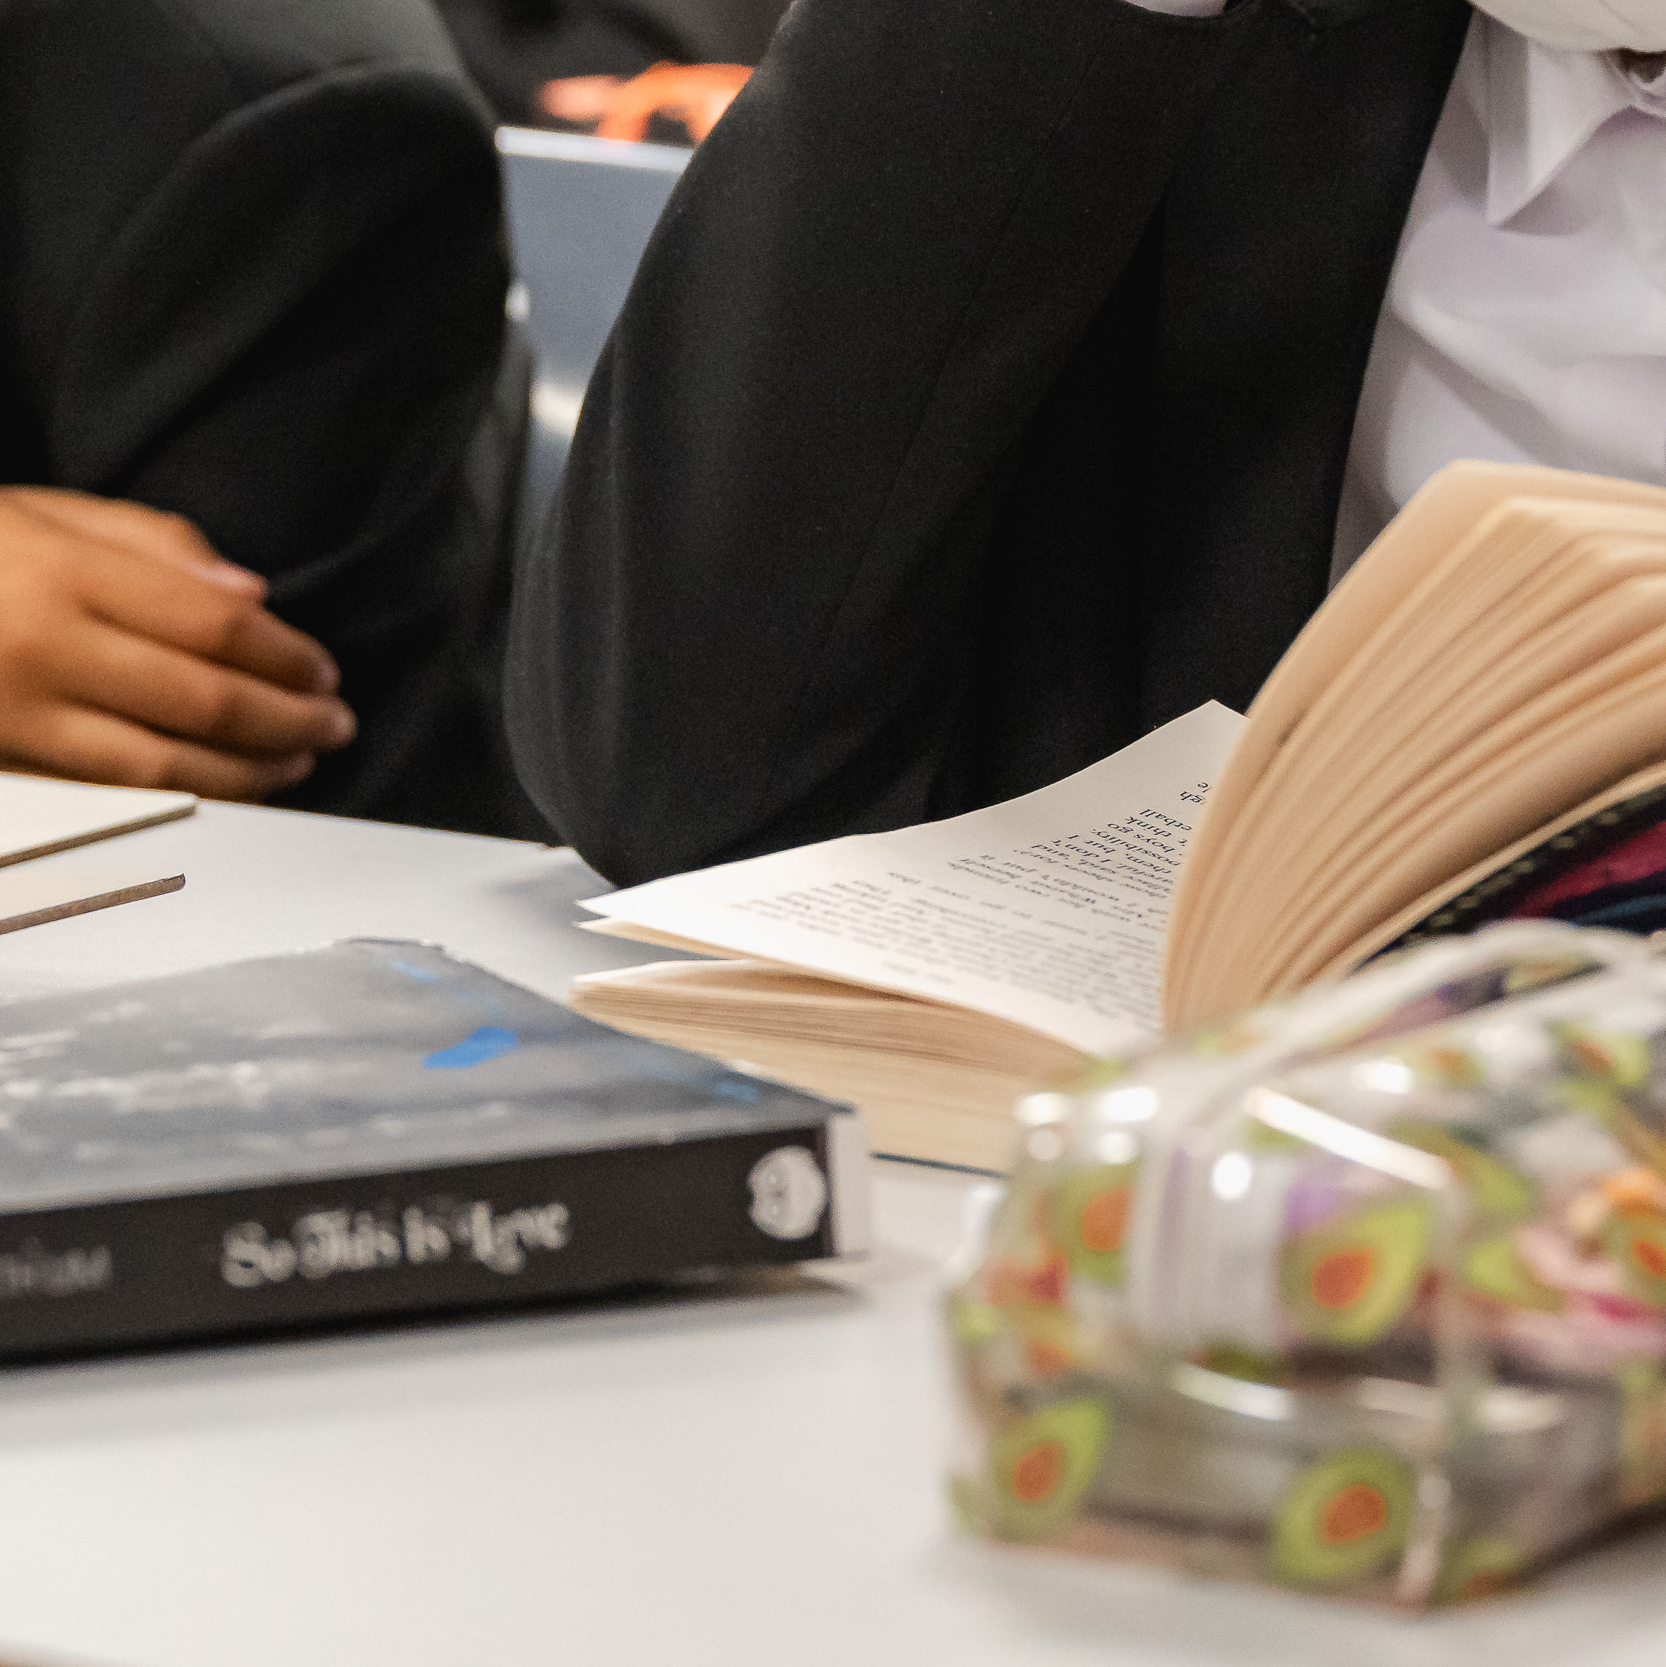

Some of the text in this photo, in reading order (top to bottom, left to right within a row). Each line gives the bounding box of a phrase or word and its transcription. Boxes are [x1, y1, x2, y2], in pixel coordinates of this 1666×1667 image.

[1125, 817, 1173, 838] think
[1139, 809, 1193, 831] etball
[1085, 841, 1117, 854] but
[1092, 829, 1181, 867] possibility.
[1107, 824, 1176, 853] boys go
[1052, 840, 1101, 858] don't
[1117, 864, 1174, 884] areful.
[1125, 854, 1173, 874] them,
[1123, 876, 1171, 893] allace
[221, 1221, 297, 1289] So
